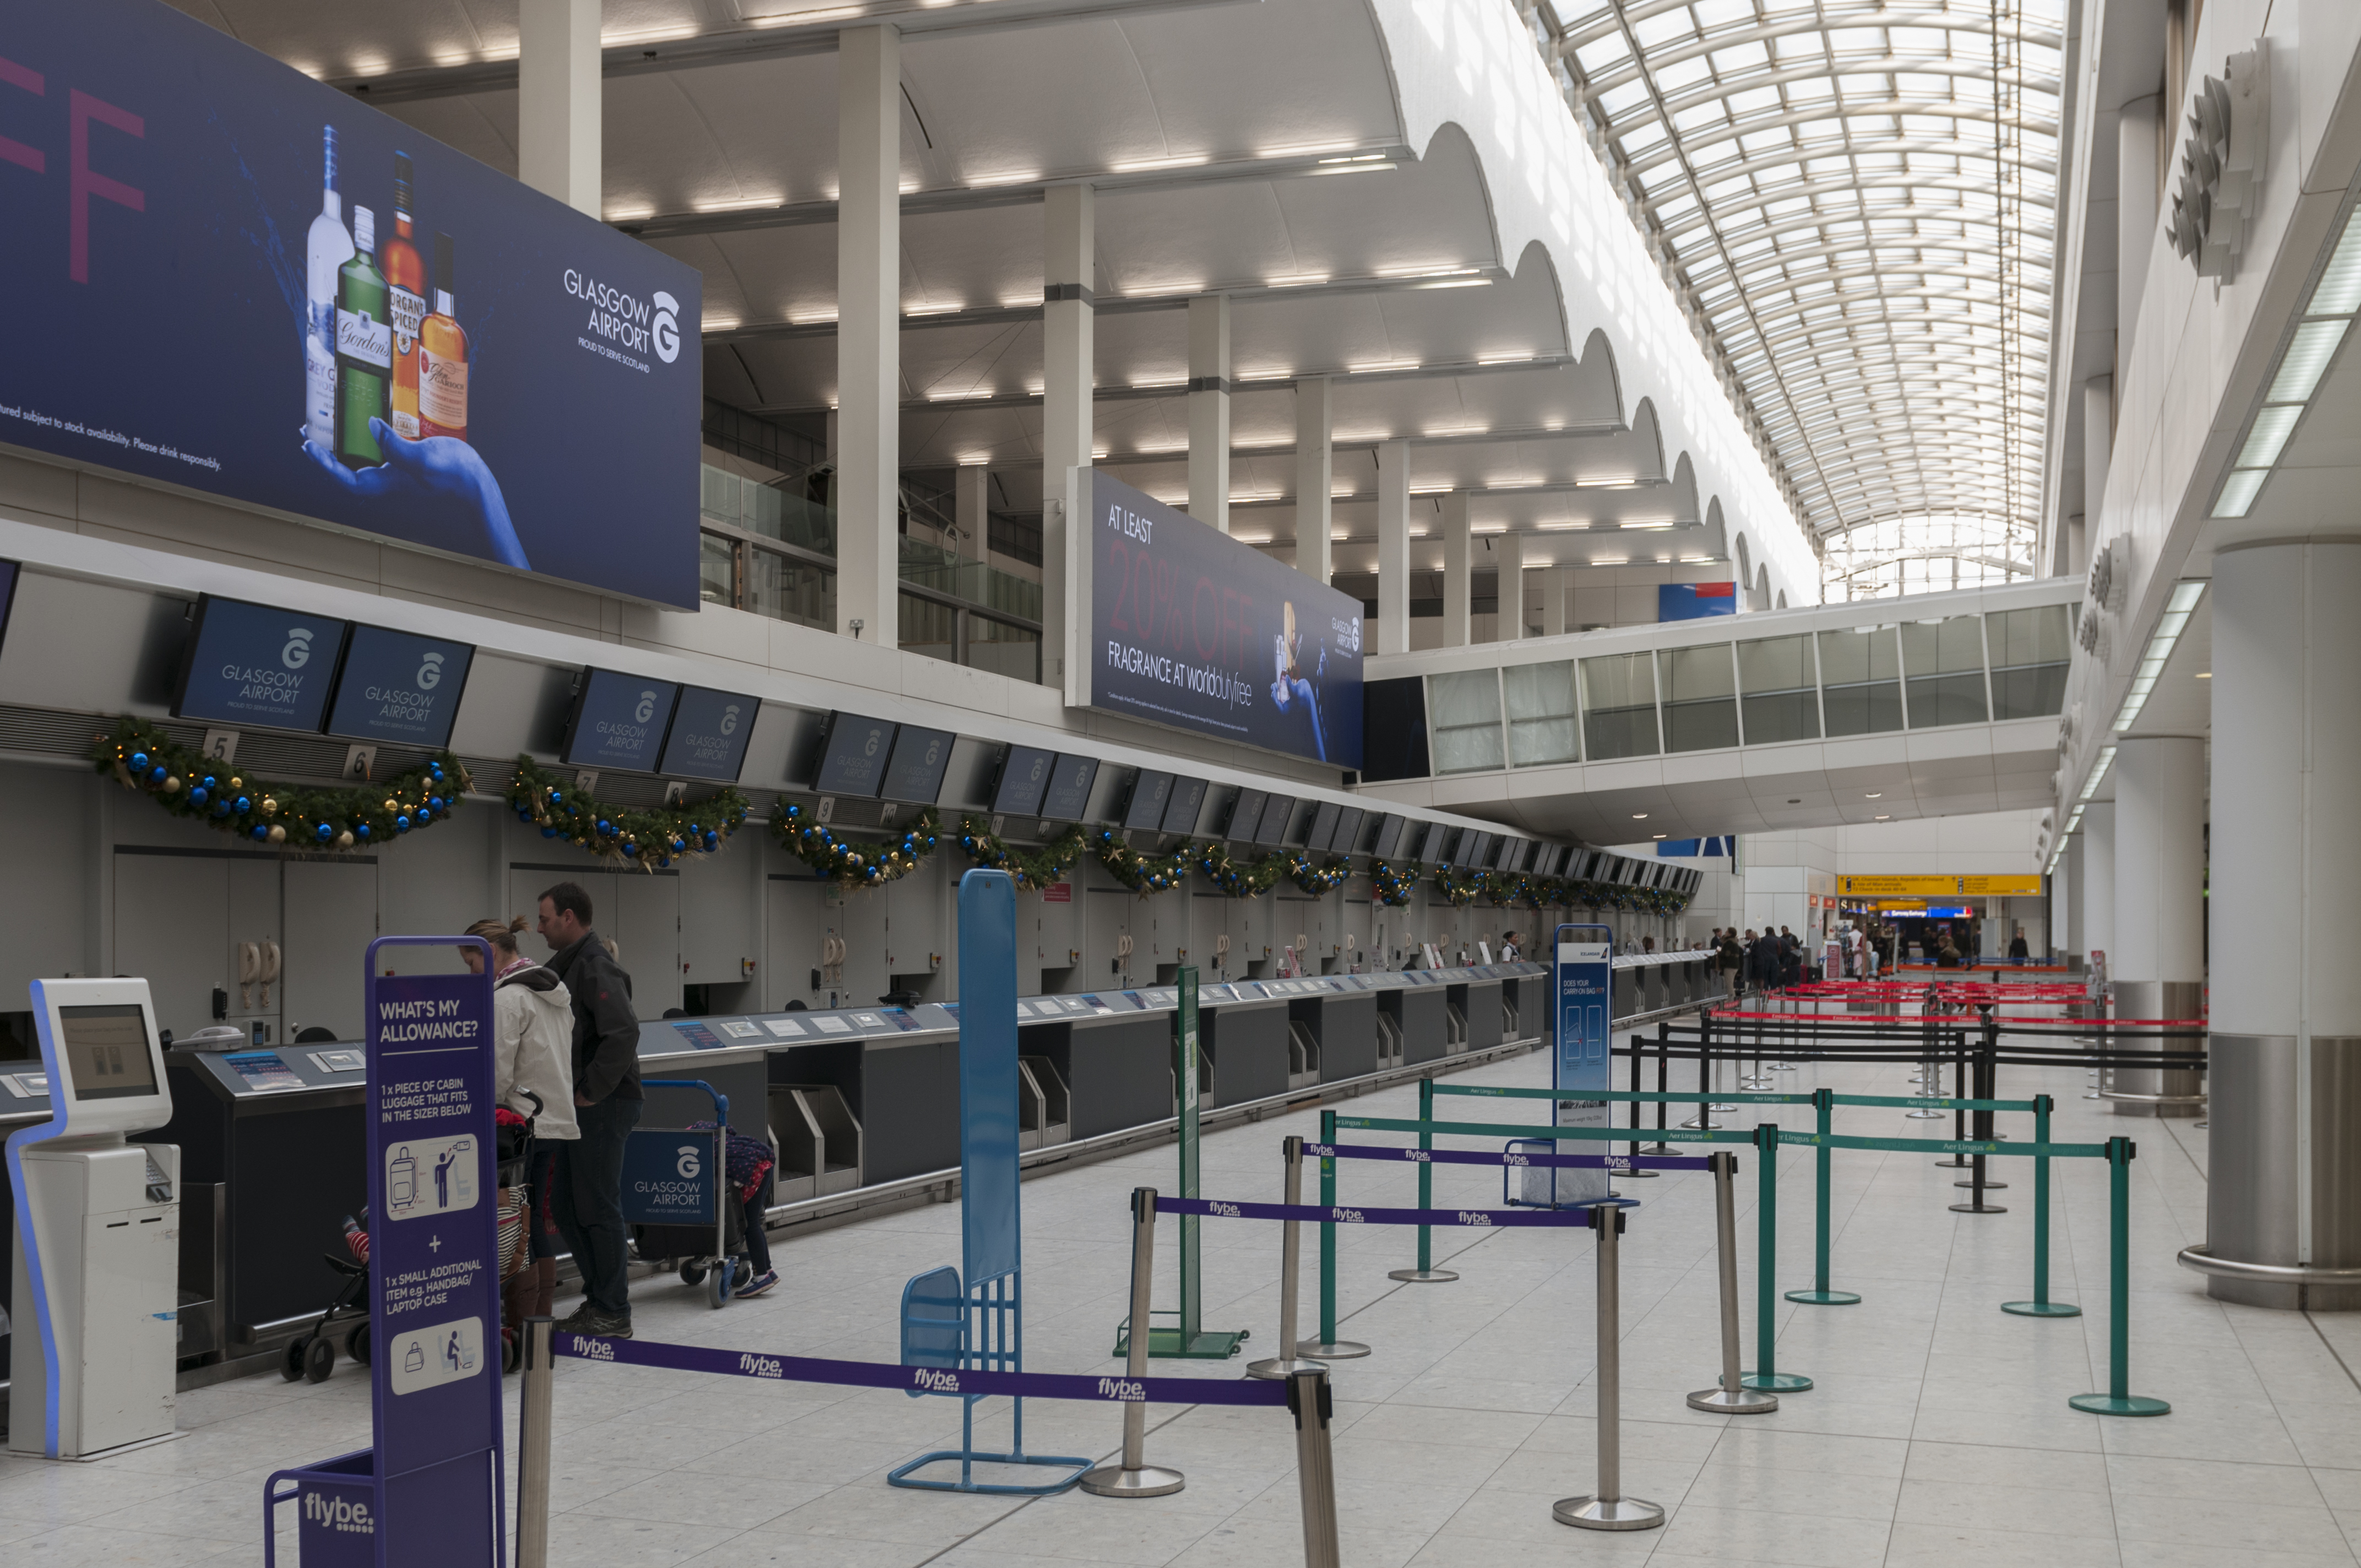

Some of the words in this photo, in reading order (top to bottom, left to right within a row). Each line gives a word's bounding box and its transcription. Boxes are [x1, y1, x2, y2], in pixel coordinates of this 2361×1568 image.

[564, 269, 650, 326] GLASGOW
[338, 317, 390, 358] Gordon's
[588, 308, 650, 353] AIRPORT
[578, 336, 597, 352] PROUD
[597, 344, 606, 356] TO
[606, 348, 622, 362] SERVE
[622, 355, 650, 373] SCOTLAND
[23, 410, 53, 426] subject
[55, 418, 62, 429] to
[64, 422, 85, 435] stock
[86, 428, 131, 448] availability.
[134, 437, 157, 453] Please
[159, 444, 178, 459] drink
[180, 452, 221, 472] responsibly.
[1108, 503, 1122, 530] AT
[1124, 513, 1152, 545] LEAST
[1109, 539, 1183, 652] 20%
[1192, 576, 1253, 671] OFF
[1331, 617, 1352, 636] GLASGOW
[1108, 640, 1171, 684] FRAGRANCE
[1173, 662, 1185, 687] AT
[222, 665, 303, 688] GLASGOW
[239, 684, 300, 704] AIRPORT
[366, 687, 434, 708] GLASGOW
[227, 702, 245, 710] PROUD
[268, 706, 295, 715] SCOTLAND
[379, 704, 431, 723] AIRPORT
[369, 720, 384, 728] PROUD
[404, 723, 426, 732] SCOTLAND
[596, 721, 648, 739] GLASGOW
[213, 737, 228, 760] 5
[606, 737, 644, 752] AIRPORT
[686, 734, 732, 750] GLASGOW
[353, 752, 367, 773] 6
[694, 748, 728, 762] AIRPORT
[837, 755, 873, 769] GLASGOW
[843, 767, 871, 778] AIRPORT
[900, 765, 933, 777] GLASGOW
[581, 776, 591, 791] 7
[906, 776, 931, 787] AIRPORT
[1010, 781, 1036, 791] GLASGOW
[670, 787, 679, 805] 8
[1013, 791, 1034, 801] AIRPORT
[1056, 787, 1081, 797] GLASGOW
[822, 801, 830, 818] 9
[884, 807, 895, 824] 10
[992, 819, 1002, 832] 11
[379, 1000, 435, 1020] WHAT'S
[438, 999, 460, 1017] MY
[380, 1020, 478, 1043] ALLOWANCE?
[382, 1084, 385, 1096] 1
[388, 1087, 393, 1095] x
[395, 1082, 421, 1095] PIECE
[422, 1081, 435, 1092] OF
[437, 1078, 463, 1090] CABIN
[382, 1096, 425, 1109] LUGGAGE
[427, 1093, 448, 1104] THAT
[450, 1091, 468, 1102] FITS
[1918, 1099, 1940, 1108] Lingus
[382, 1112, 391, 1123] IN
[394, 1110, 412, 1121] THE
[414, 1107, 438, 1119] SIZER
[440, 1103, 471, 1117] BELOW
[1681, 1133, 1703, 1141] Lingus
[1784, 1134, 1809, 1144] Lingus
[1958, 1144, 1984, 1153] Lingus
[635, 1181, 700, 1193] GLASGOW
[653, 1194, 701, 1205] AIRPORT
[385, 1277, 390, 1288] 1
[391, 1278, 397, 1287] x
[399, 1272, 428, 1286] SMALL
[430, 1259, 482, 1280] ADDITIONAL
[386, 1287, 407, 1302] ITEM
[409, 1286, 425, 1298] e.g.
[426, 1272, 472, 1293] HANDBAG/
[387, 1298, 422, 1315] LAPTOP
[424, 1292, 448, 1308] CASE
[573, 1335, 614, 1361] flybe.
[740, 1353, 783, 1378] flybe.
[915, 1368, 960, 1392] flybe.
[1098, 1378, 1146, 1401] flybe.
[304, 1492, 374, 1533] flybe.
